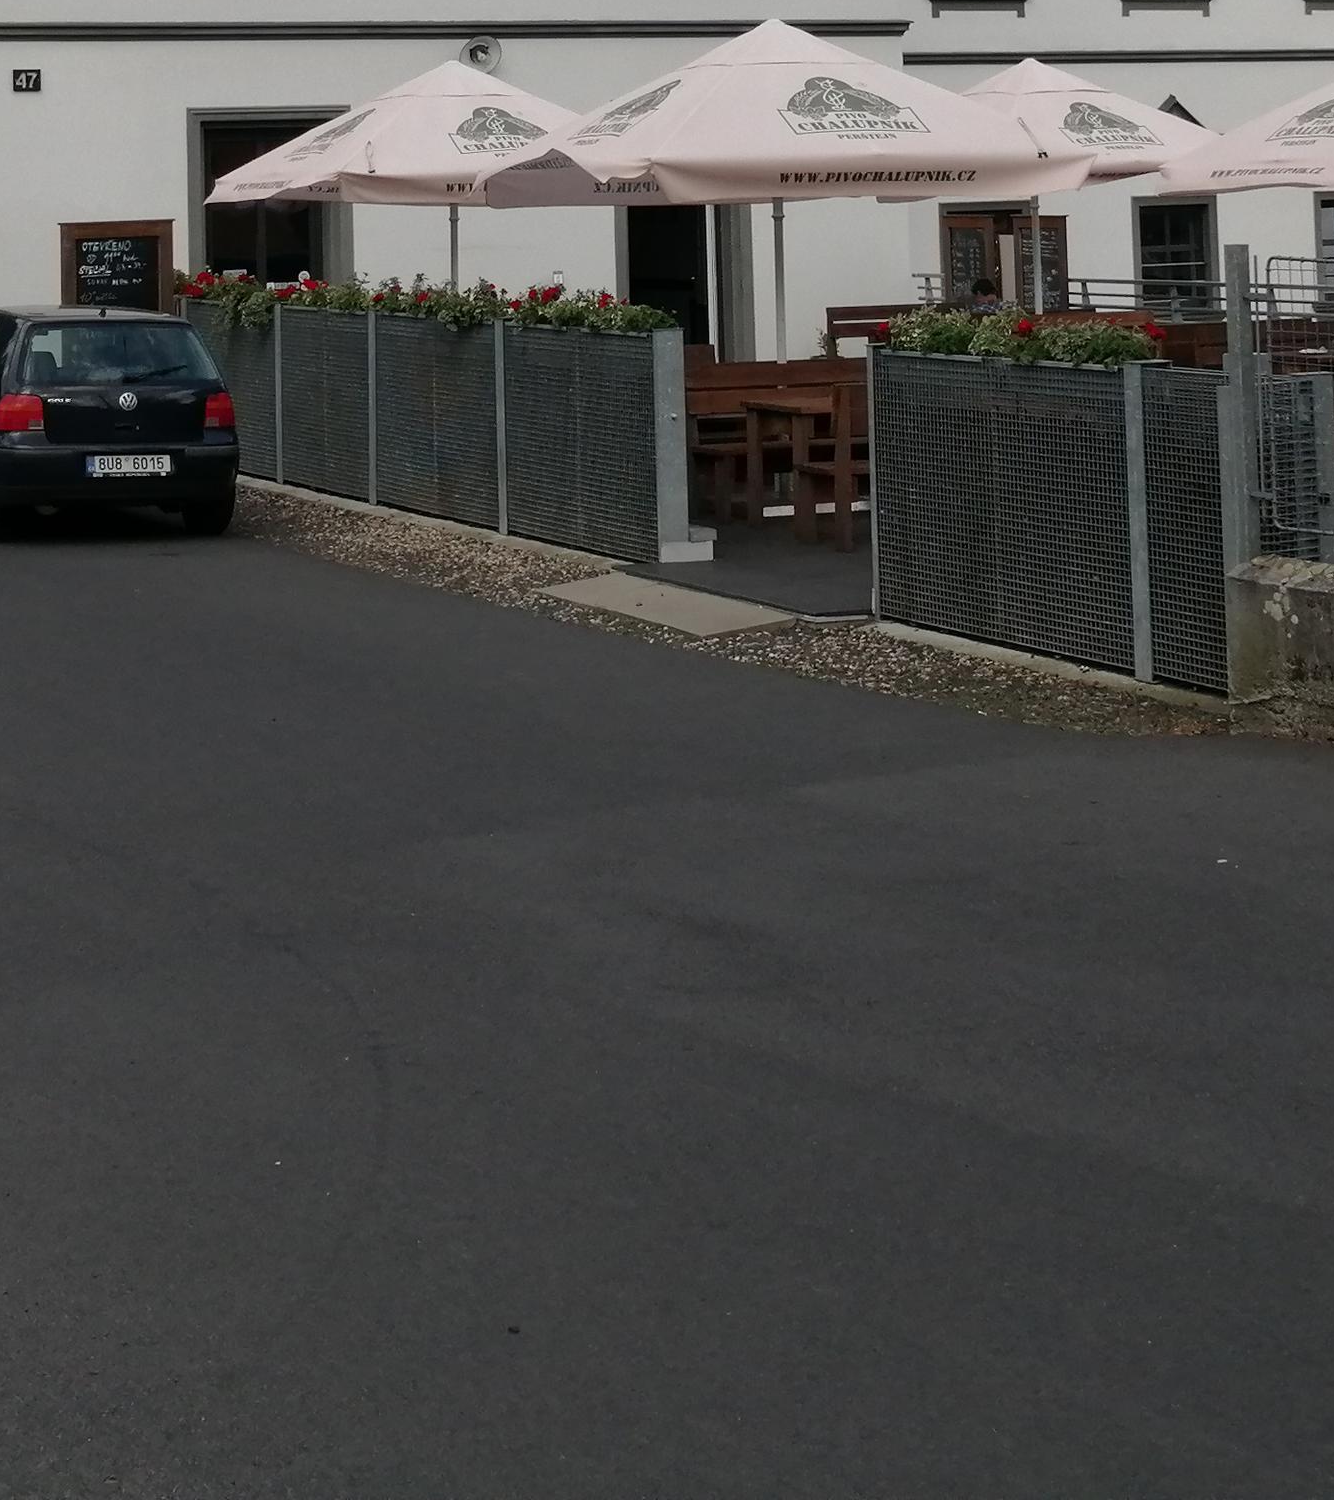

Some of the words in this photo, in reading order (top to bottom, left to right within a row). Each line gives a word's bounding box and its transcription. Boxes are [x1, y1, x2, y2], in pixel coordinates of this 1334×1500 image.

[15, 72, 38, 89] 47
[779, 170, 977, 184] WWW.PIVOCHALUPNIK.CZ
[98, 457, 123, 470] 8U8
[132, 456, 165, 470] 6015
